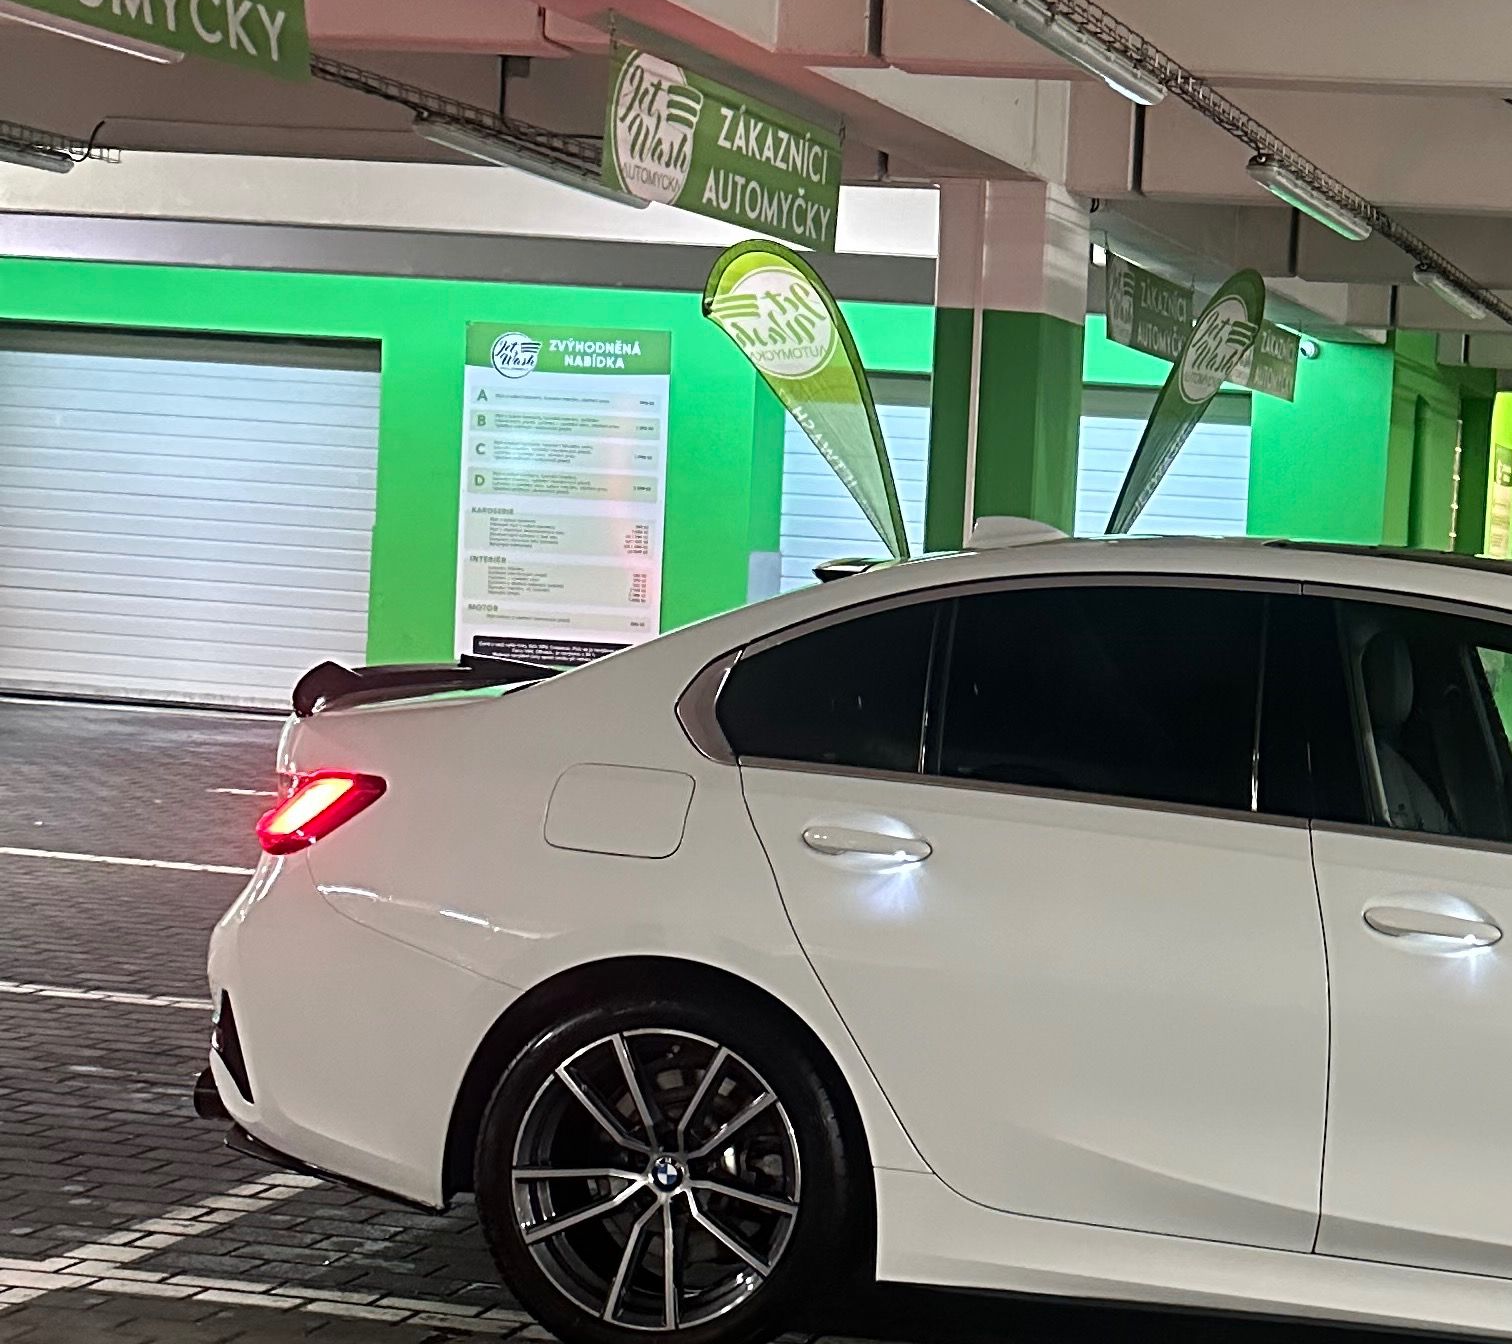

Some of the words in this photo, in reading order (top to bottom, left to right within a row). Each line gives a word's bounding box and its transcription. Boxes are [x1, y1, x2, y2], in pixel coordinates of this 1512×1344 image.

[617, 64, 666, 124] Jet
[627, 108, 689, 174] Wash
[717, 104, 828, 185] ZÁKAZNÍCI
[702, 167, 831, 242] AUTOMYČKY
[1191, 310, 1233, 348] Jet
[549, 337, 642, 356] ZVÝHODNĚNÁ
[1191, 336, 1239, 376] Wash
[500, 351, 535, 367] Wash
[564, 353, 625, 369] NABÍDKA
[476, 389, 488, 402] A
[477, 415, 487, 427] B
[475, 442, 486, 455] C
[474, 474, 485, 487] D
